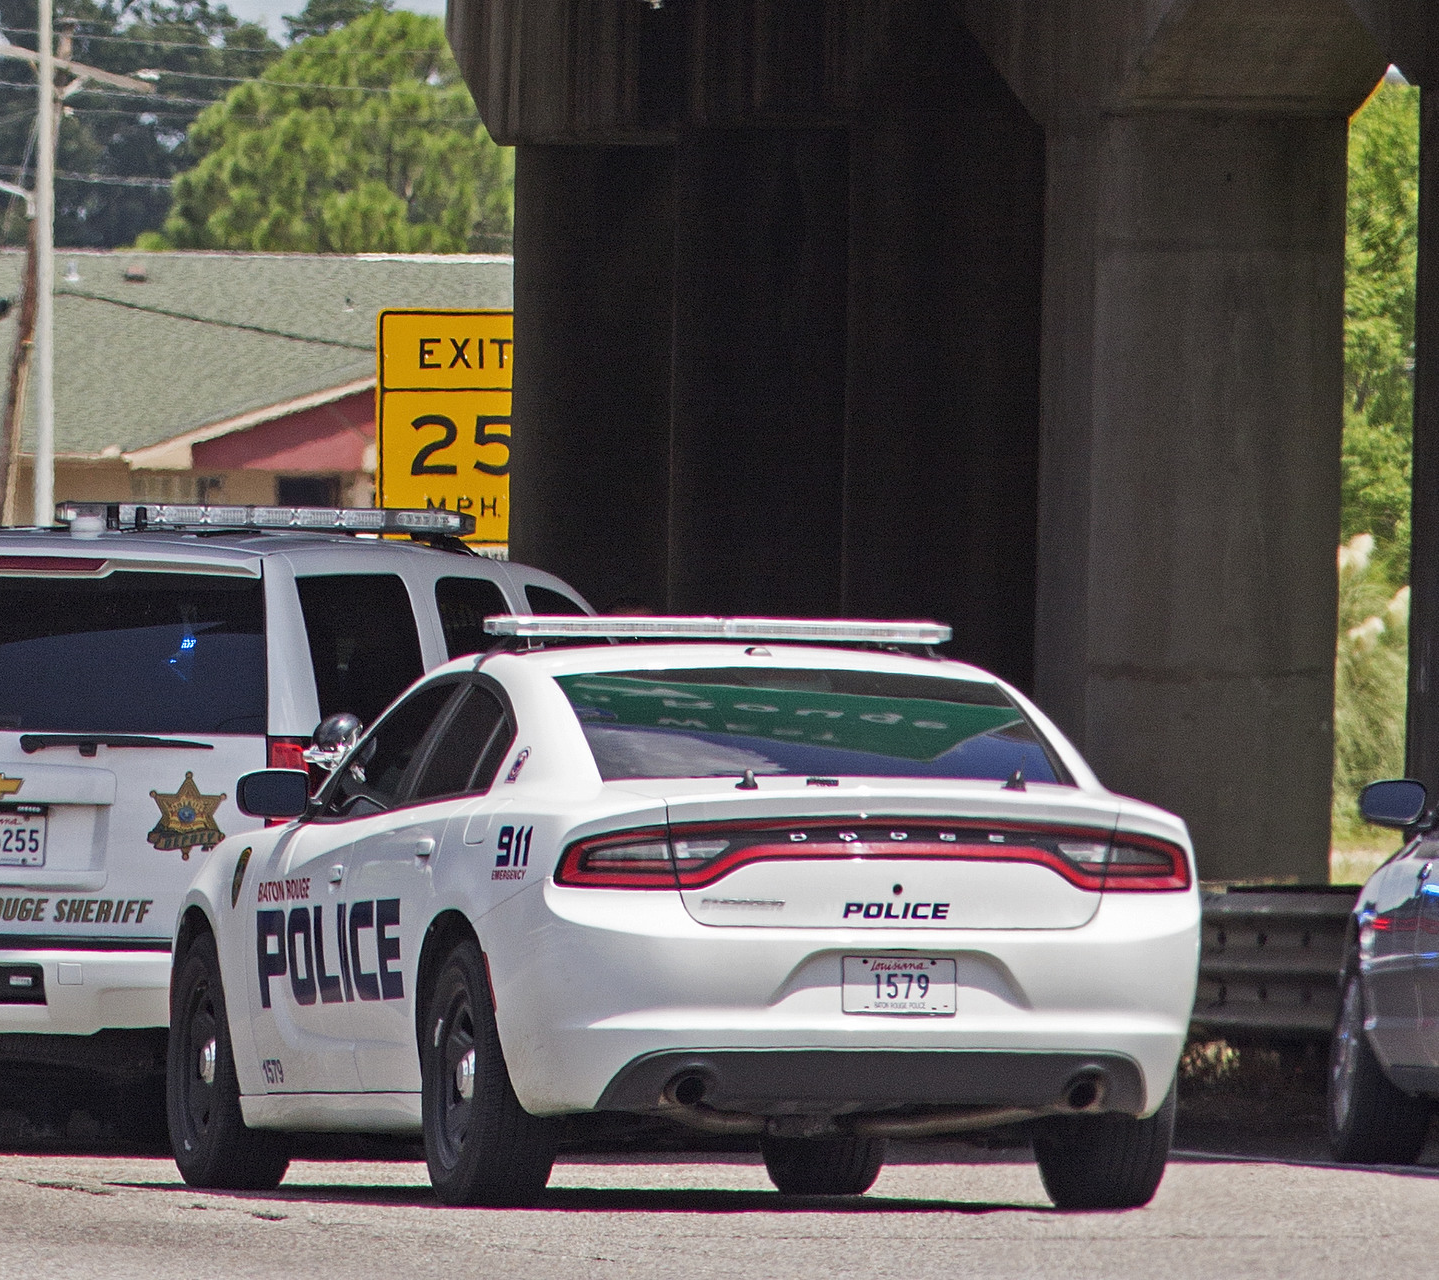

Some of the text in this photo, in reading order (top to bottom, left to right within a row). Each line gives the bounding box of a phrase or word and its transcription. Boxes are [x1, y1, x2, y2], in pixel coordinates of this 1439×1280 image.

[419, 338, 513, 370] EXIT
[411, 414, 513, 476] 25
[496, 825, 533, 867] 911
[491, 869, 526, 881] EMERGENCY
[258, 877, 310, 902] BATON ROUGE
[53, 898, 154, 923] SHERIFF
[843, 902, 951, 919] POLICE
[256, 898, 405, 1009] POLICE
[870, 960, 930, 972] Louisiana
[874, 972, 930, 1000] 1579
[262, 1057, 284, 1084] 1579
